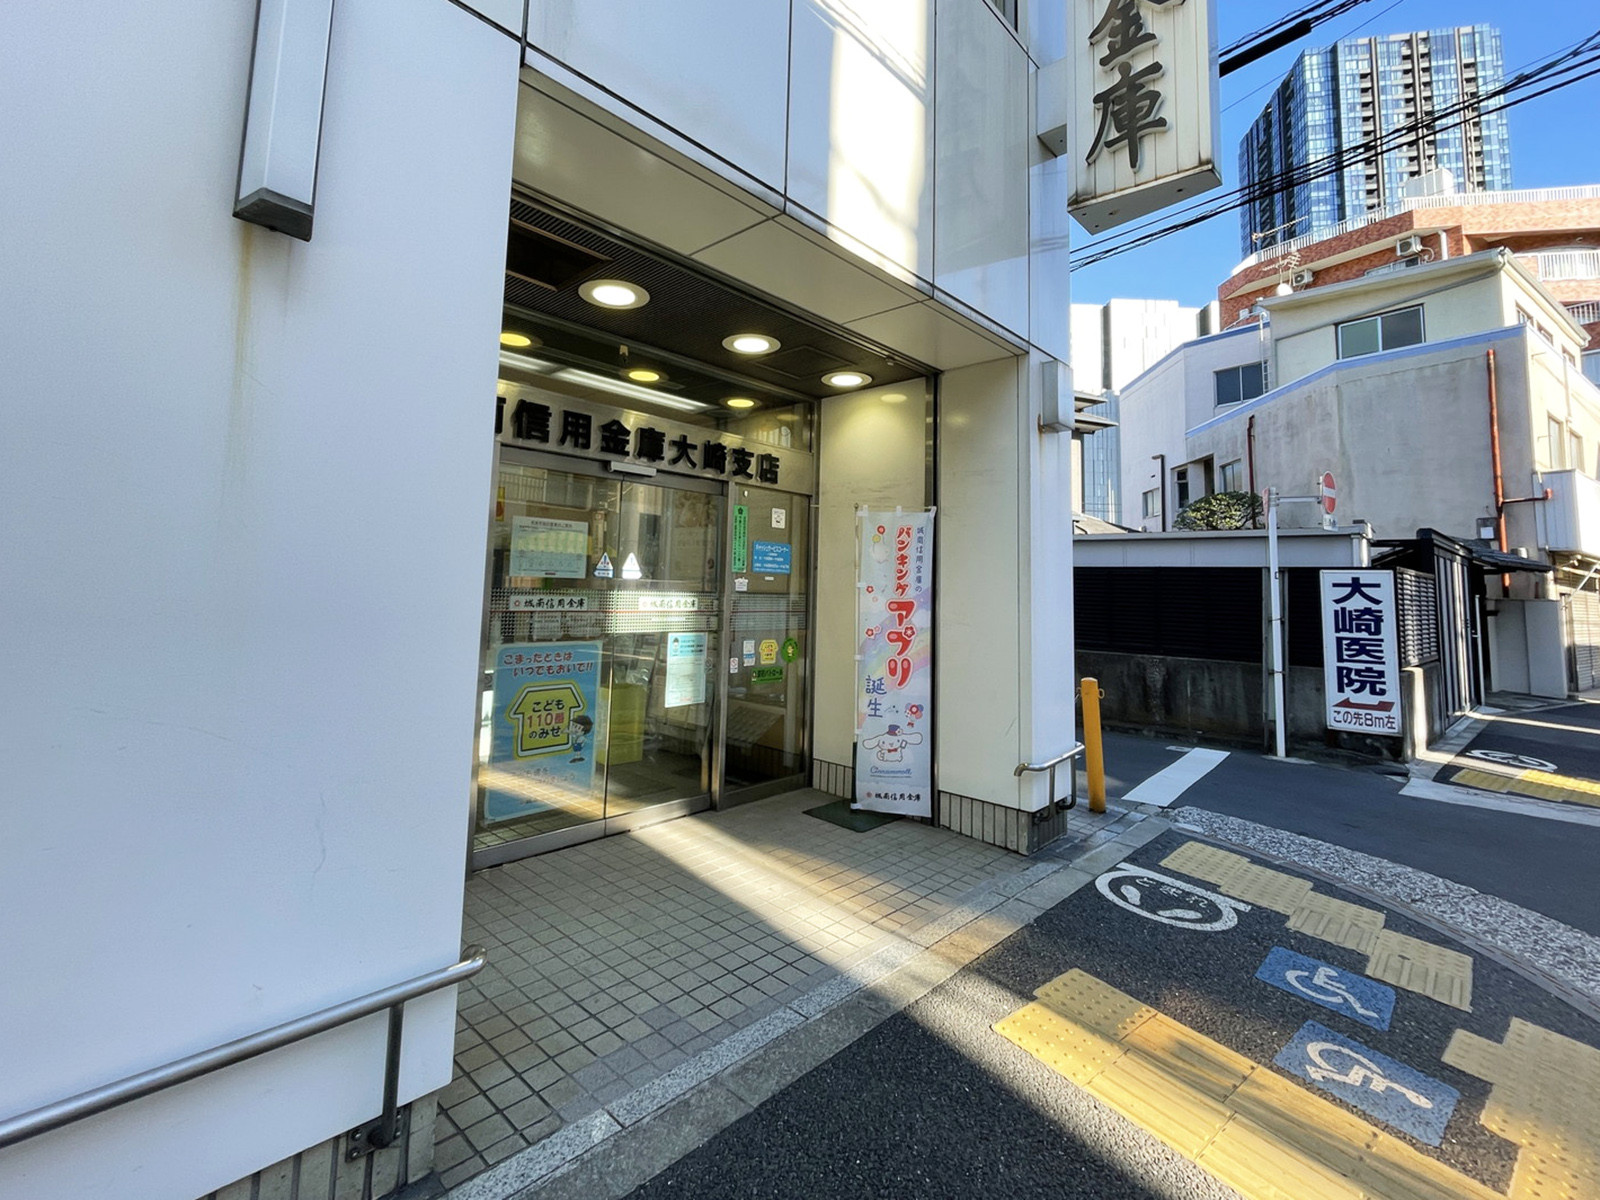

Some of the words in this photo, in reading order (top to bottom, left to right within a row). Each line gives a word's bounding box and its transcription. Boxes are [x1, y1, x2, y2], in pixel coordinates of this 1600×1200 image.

[1086, 0, 1185, 169] 金庫
[524, 596, 586, 609] 城南信用金庫
[1332, 576, 1387, 697] 大崎医院
[503, 652, 573, 665] こまったときは
[513, 662, 593, 677] いつでもおいで!!
[865, 675, 887, 718] 誕生
[532, 700, 565, 713] こども
[527, 712, 565, 727] 110番
[1333, 710, 1396, 730] この先8m左
[529, 726, 561, 739] のみせ
